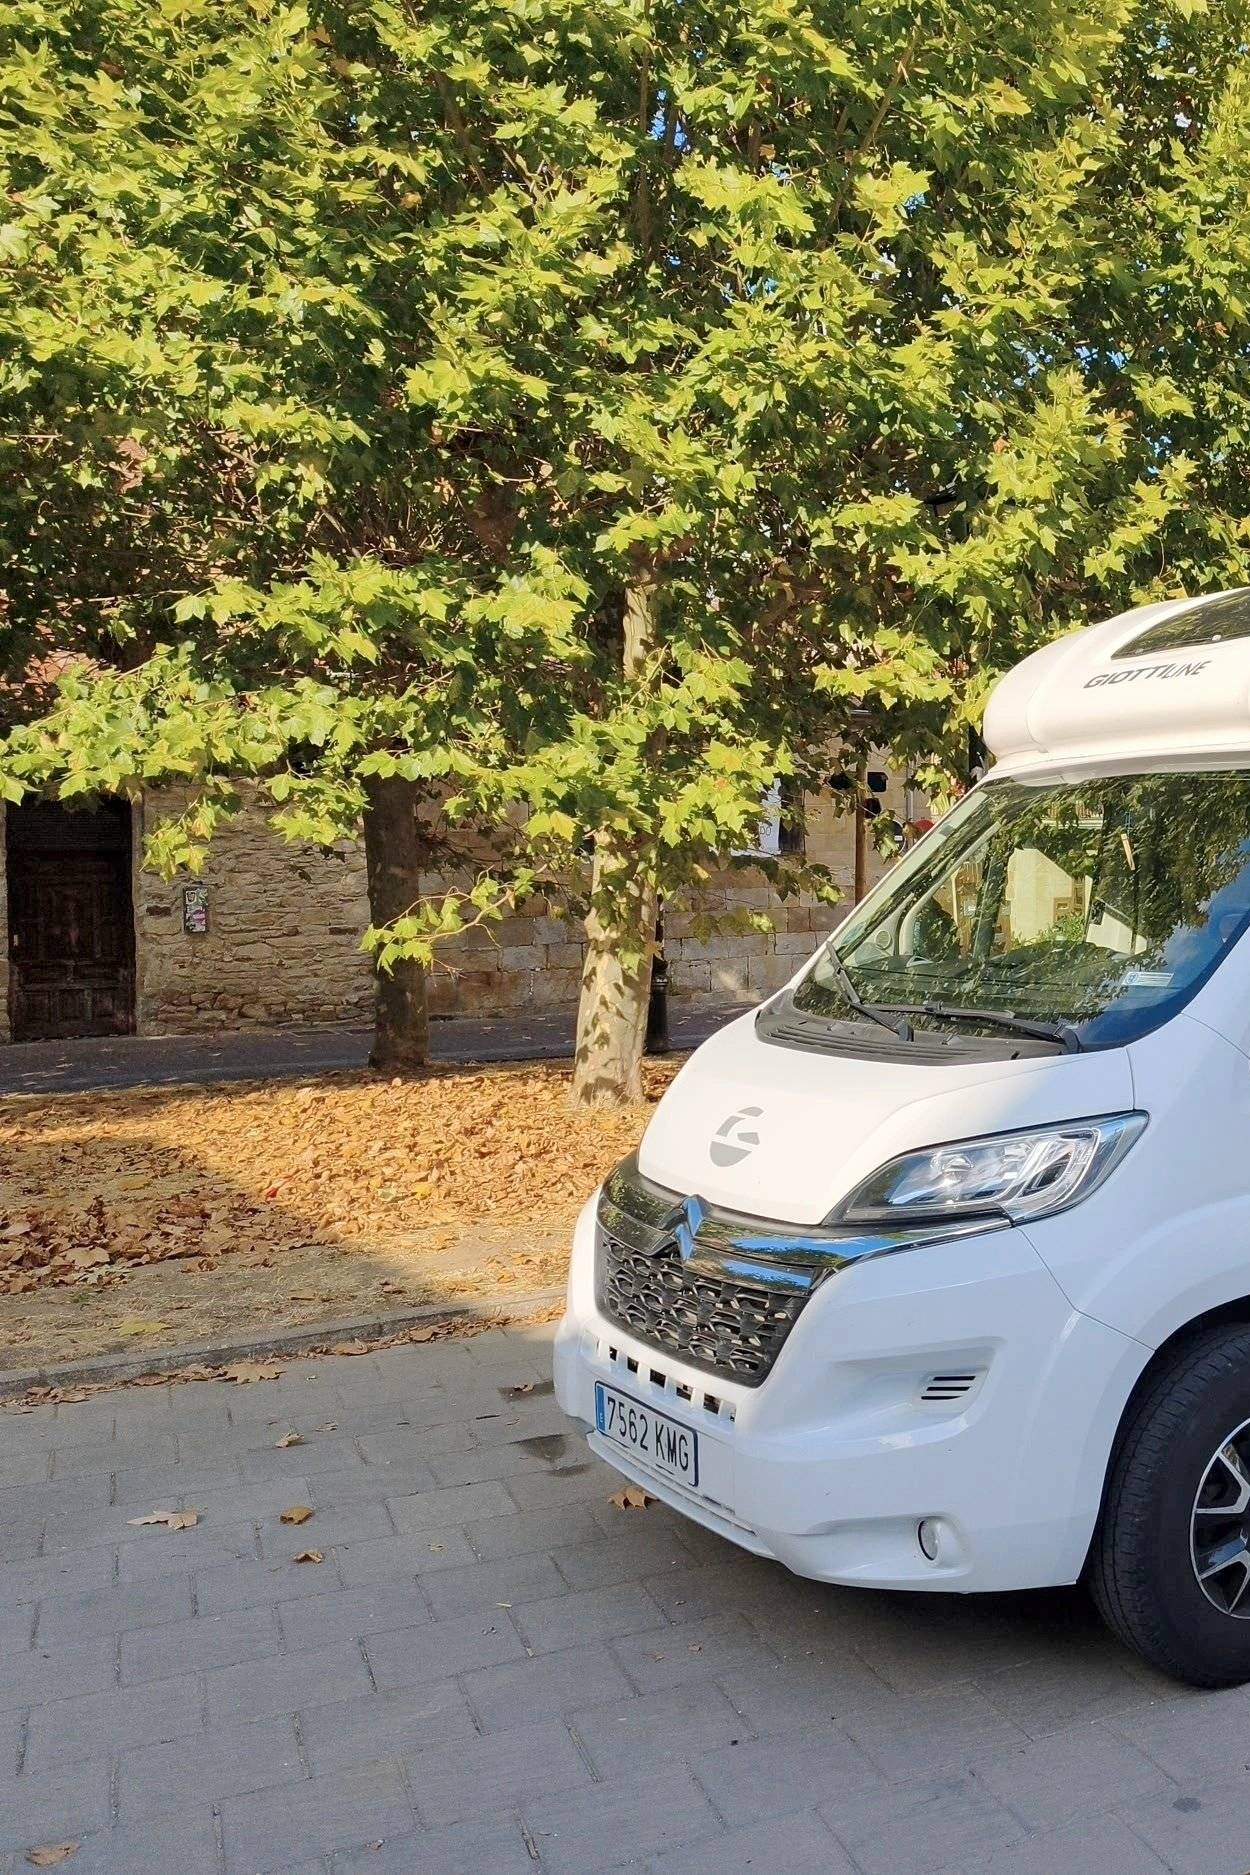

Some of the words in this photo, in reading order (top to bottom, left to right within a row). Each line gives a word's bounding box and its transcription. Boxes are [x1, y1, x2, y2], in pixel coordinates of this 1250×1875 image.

[1083, 660, 1213, 689] GIOTTILINE
[607, 1396, 649, 1451] 7562
[655, 1420, 689, 1471] KMG
